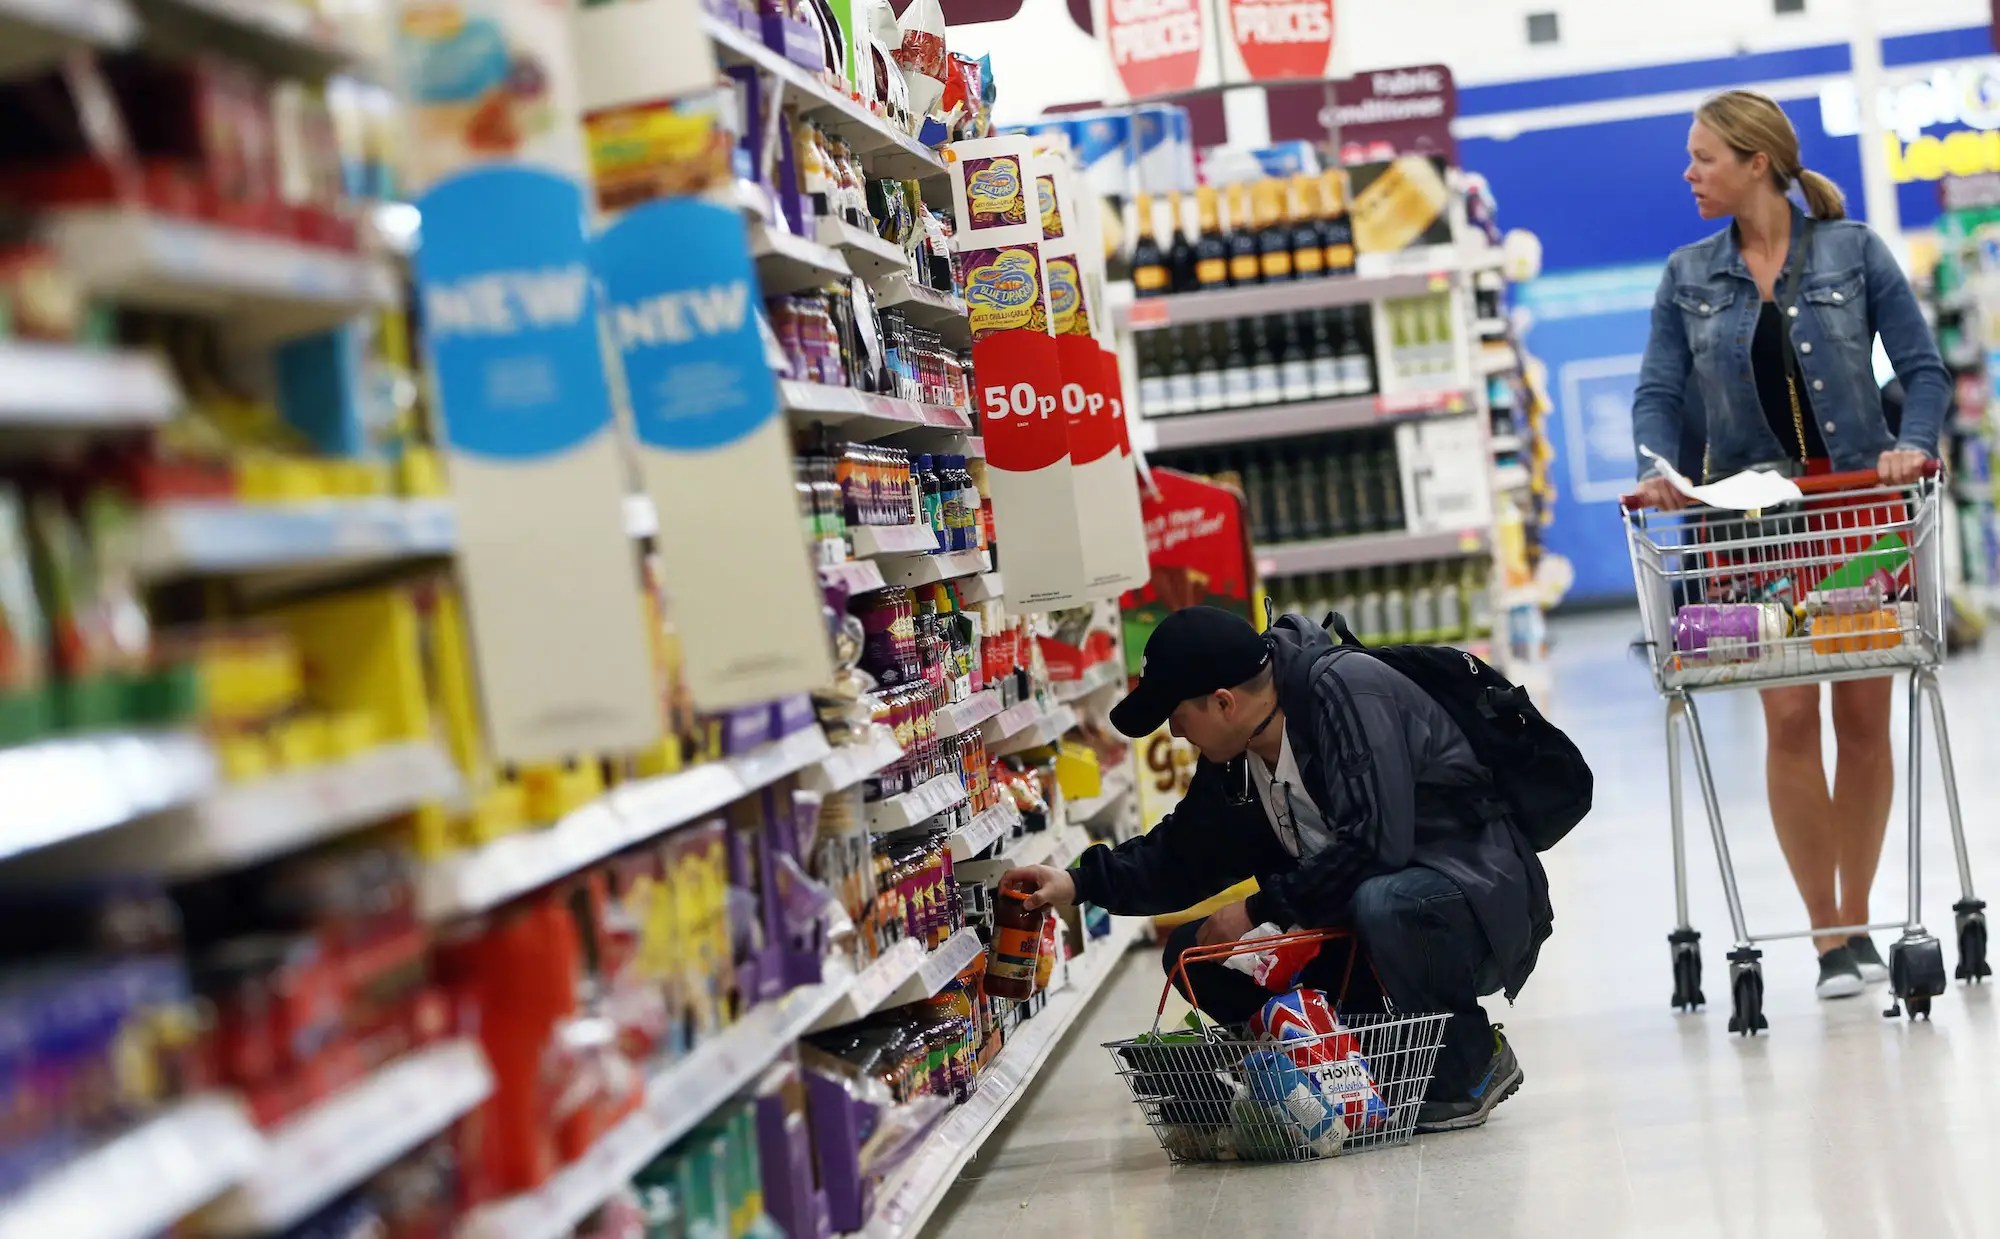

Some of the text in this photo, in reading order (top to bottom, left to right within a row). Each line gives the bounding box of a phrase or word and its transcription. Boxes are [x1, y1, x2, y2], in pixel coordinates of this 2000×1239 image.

[1111, 11, 1201, 66] PRICES
[1234, 4, 1333, 45] PRICES
[1372, 69, 1443, 96] Fabric
[426, 261, 590, 337] NEW
[979, 286, 1001, 300] BLUE
[1001, 281, 1034, 302] DRAGON
[613, 281, 748, 351] NEW
[984, 382, 1057, 420] 50p
[1061, 383, 1104, 416] 0p
[1322, 1065, 1362, 1081] HOVIS
[1328, 1083, 1344, 1093] Soft
